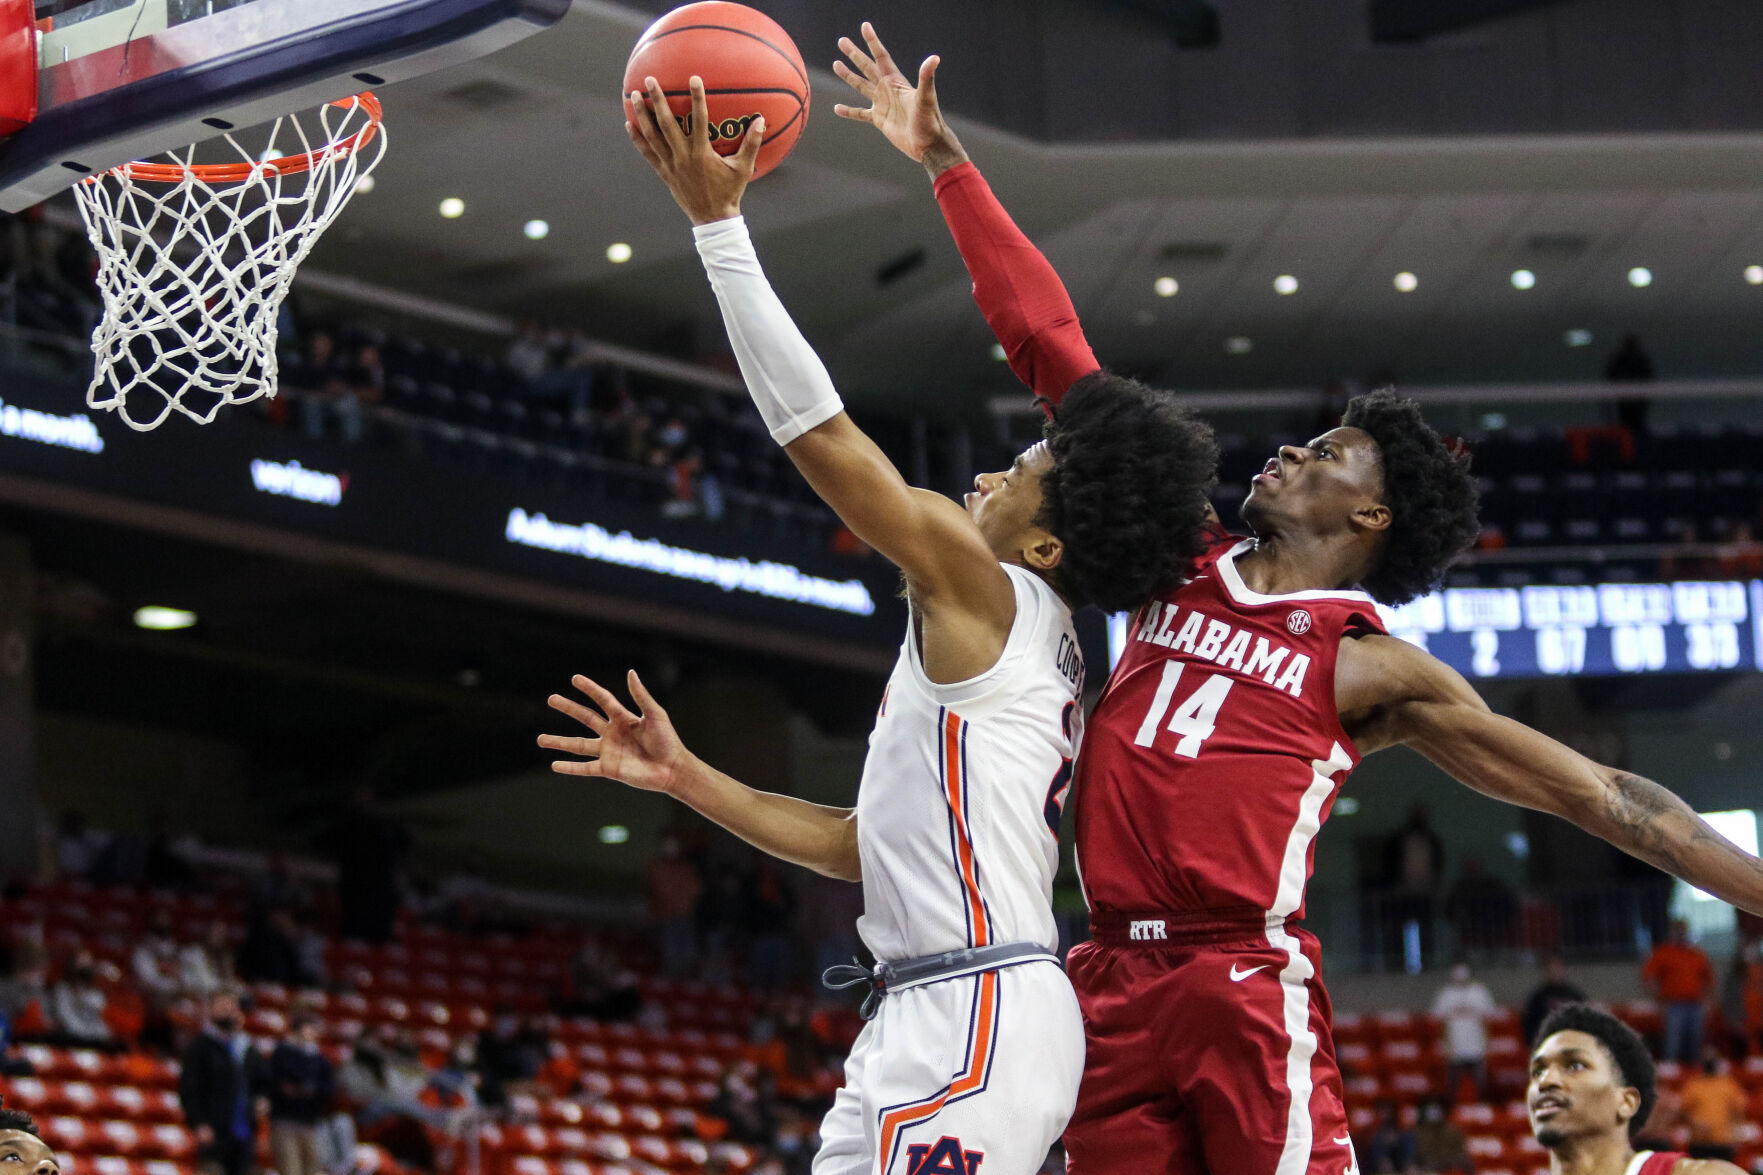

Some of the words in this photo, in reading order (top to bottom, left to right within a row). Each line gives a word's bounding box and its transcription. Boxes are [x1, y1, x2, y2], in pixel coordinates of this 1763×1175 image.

[1137, 600, 1312, 697] ALABAMA
[1289, 611, 1310, 633] SEC
[1134, 659, 1235, 759] 14
[1130, 920, 1168, 940] RTR
